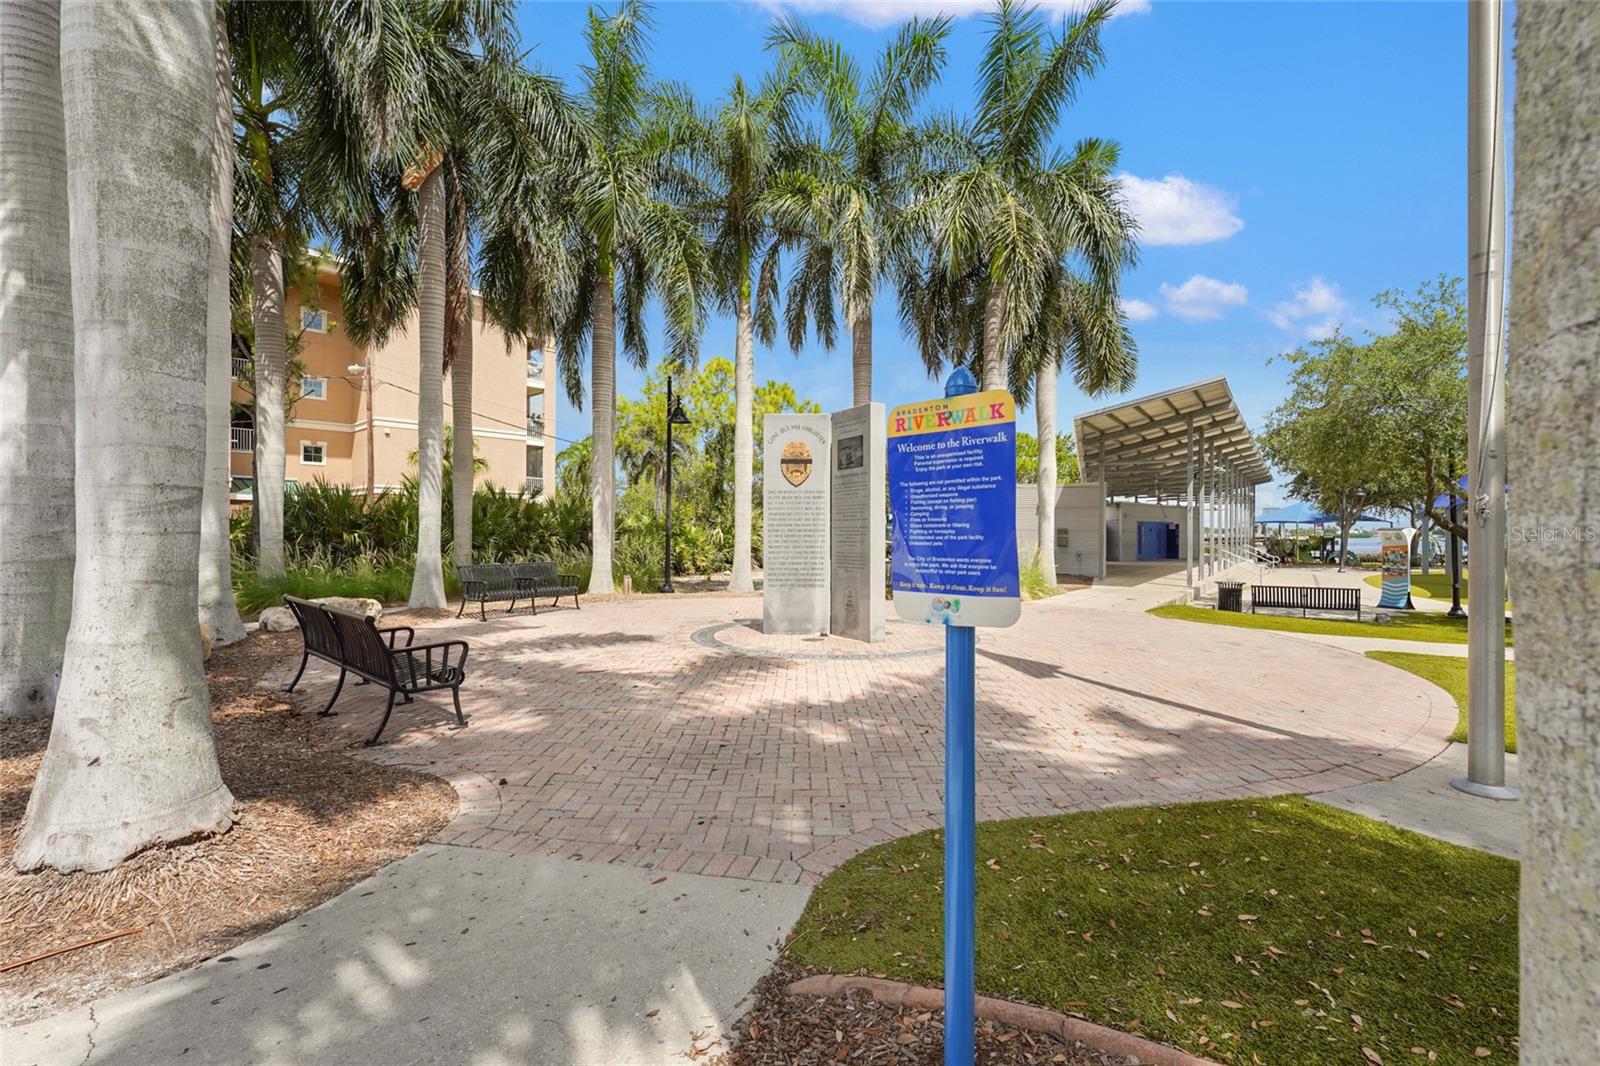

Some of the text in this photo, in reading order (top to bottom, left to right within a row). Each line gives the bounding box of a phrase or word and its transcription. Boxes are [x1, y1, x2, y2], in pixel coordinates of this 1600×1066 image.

[896, 403, 1004, 432] RIVERWALK
[897, 404, 948, 416] BRADENTON
[897, 432, 1007, 453] Welcome to the Riverwalk
[929, 582, 945, 591] Keep
[969, 585, 984, 593] Keep
